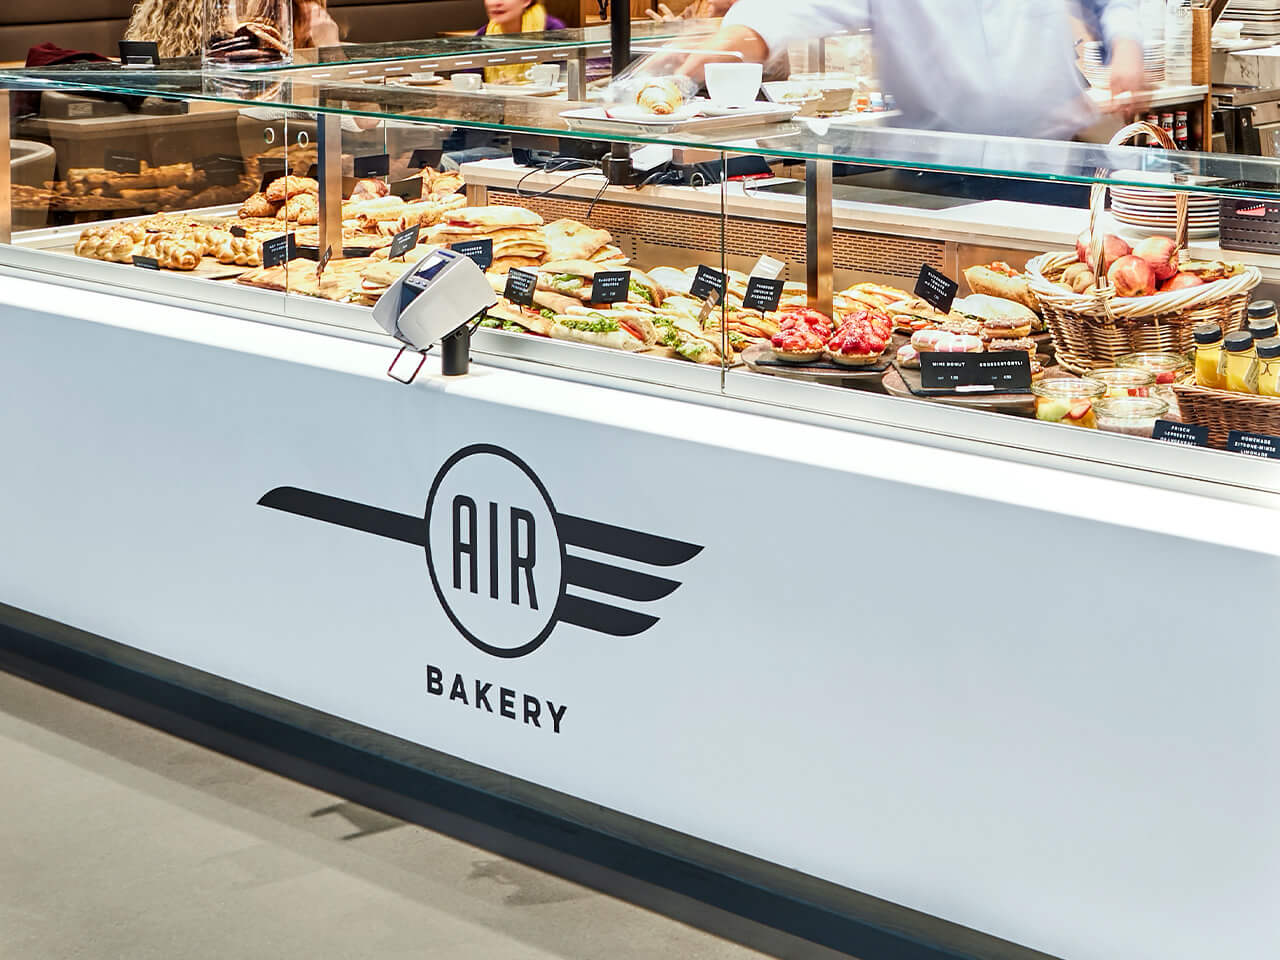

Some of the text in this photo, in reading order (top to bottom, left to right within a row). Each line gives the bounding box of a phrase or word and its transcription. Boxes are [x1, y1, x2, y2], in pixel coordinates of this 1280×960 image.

[1171, 425, 1190, 433] FRISCH
[1241, 436, 1271, 446] HOMEMADE
[452, 494, 538, 610] AIR
[426, 664, 567, 734] BAKERY
